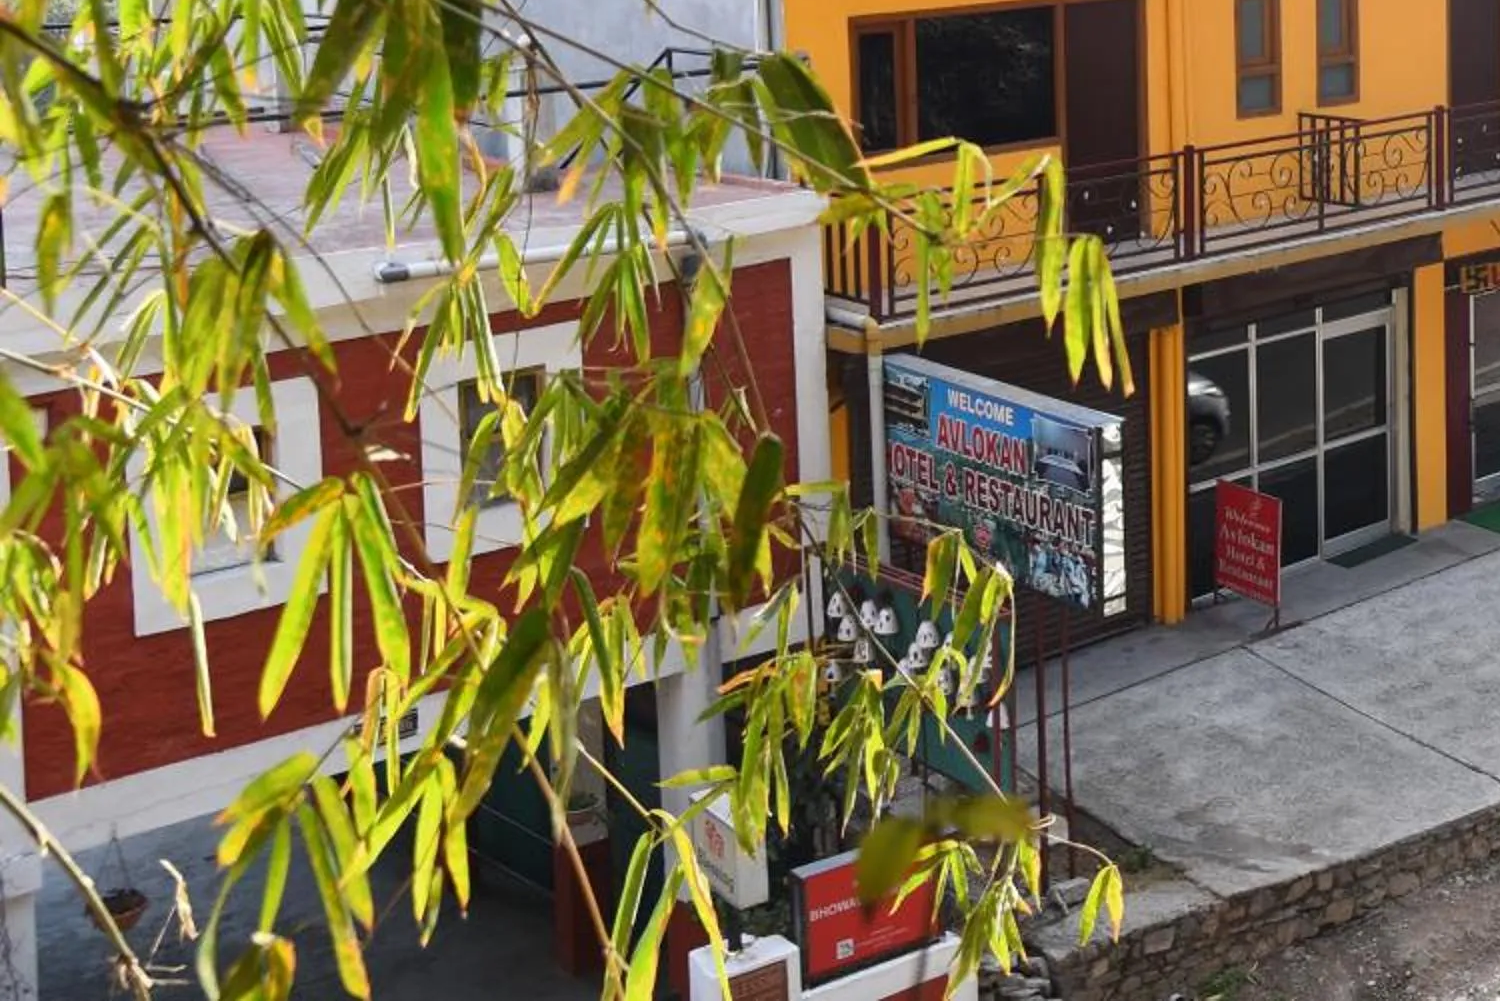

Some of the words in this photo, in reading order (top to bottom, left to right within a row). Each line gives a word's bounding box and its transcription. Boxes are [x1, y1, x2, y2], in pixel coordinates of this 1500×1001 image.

[947, 388, 1015, 426] WELCOME
[936, 414, 1028, 478] AVLOKAN
[945, 463, 957, 500] &
[962, 467, 1096, 548] RESTAURANT
